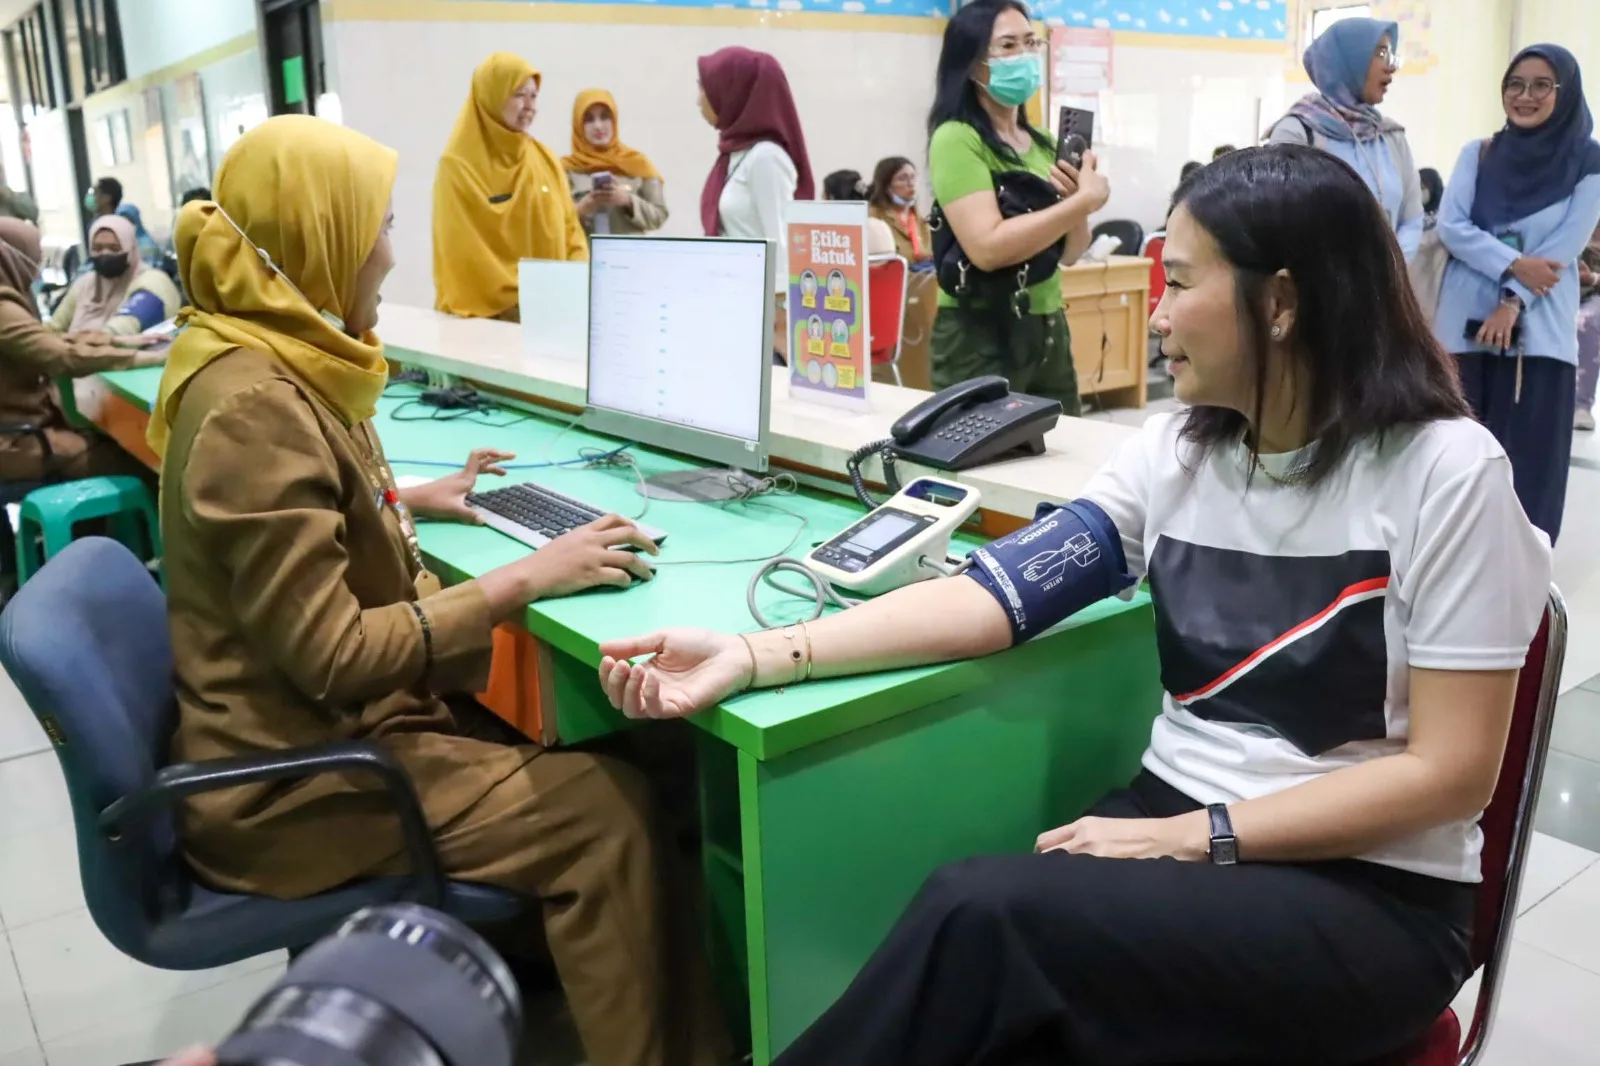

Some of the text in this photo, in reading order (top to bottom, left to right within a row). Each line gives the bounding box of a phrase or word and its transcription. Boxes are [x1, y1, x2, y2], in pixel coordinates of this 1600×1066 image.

[811, 229, 850, 248] Etika
[811, 246, 856, 266] Batuk
[993, 566, 1012, 591] RANGE
[1043, 576, 1063, 592] ARTERY
